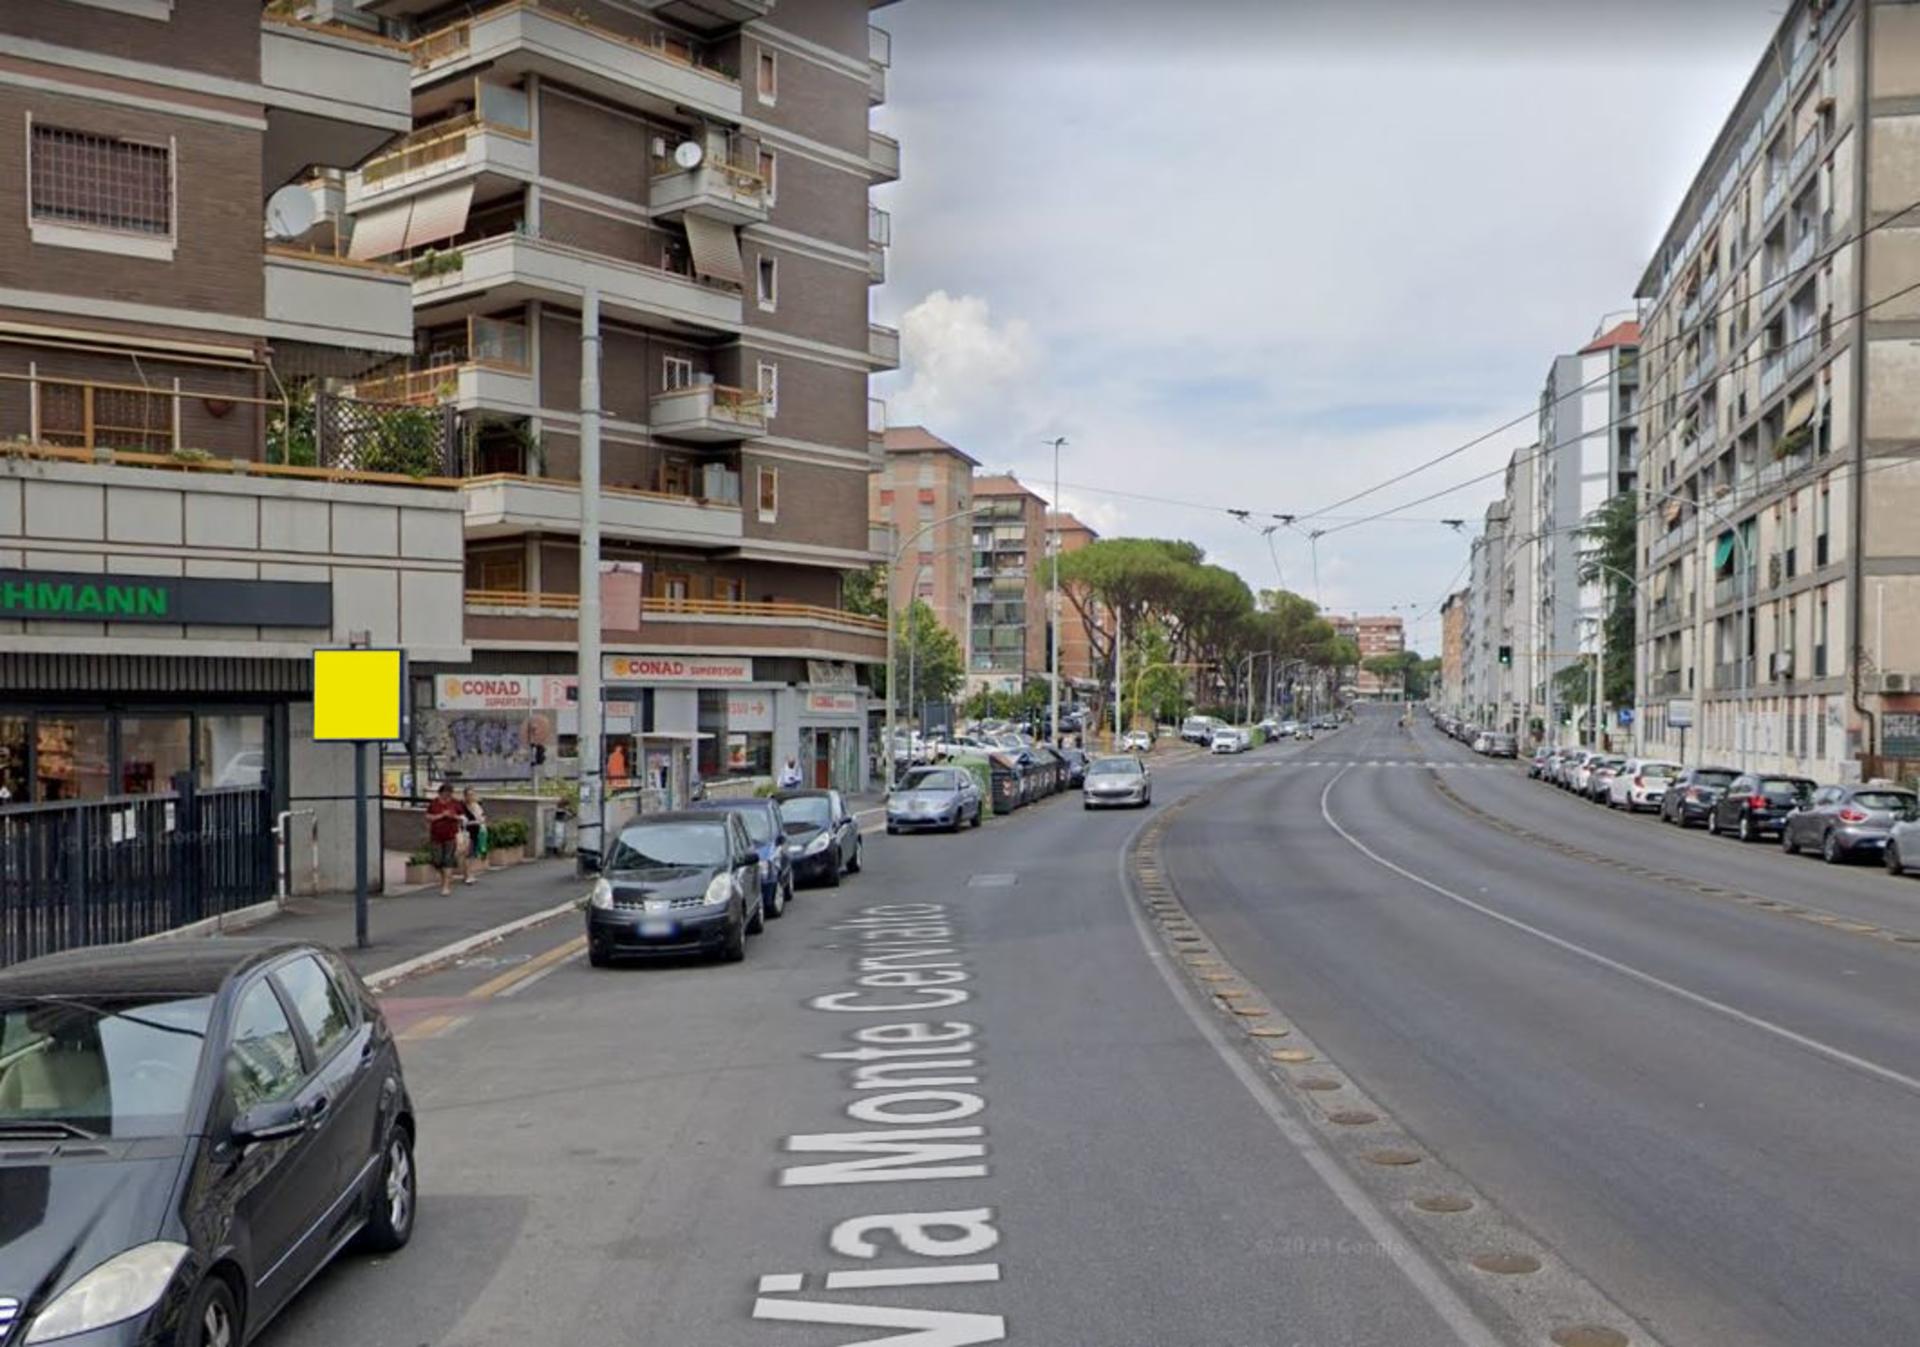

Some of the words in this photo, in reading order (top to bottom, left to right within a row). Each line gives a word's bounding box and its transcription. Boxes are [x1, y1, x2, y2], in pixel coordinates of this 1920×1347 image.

[0, 581, 167, 615] HMANN
[629, 660, 684, 676] CONAD
[462, 680, 521, 696] CONAD
